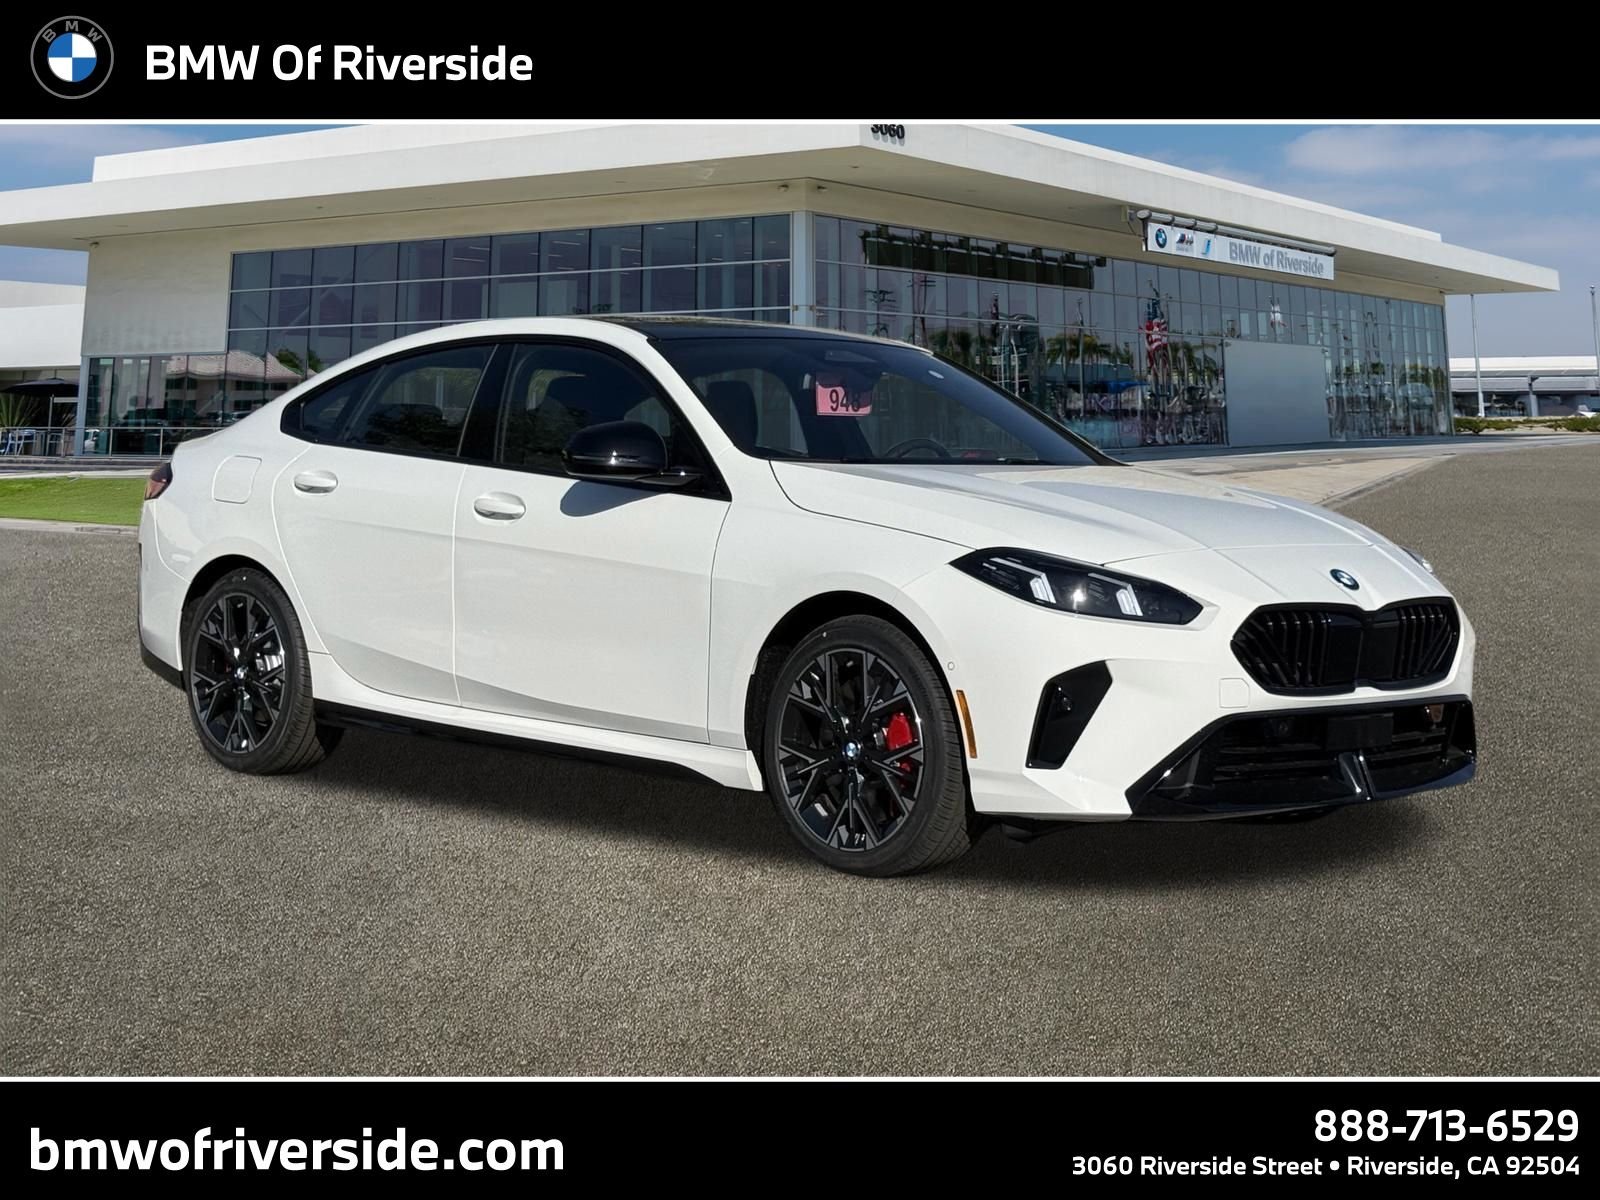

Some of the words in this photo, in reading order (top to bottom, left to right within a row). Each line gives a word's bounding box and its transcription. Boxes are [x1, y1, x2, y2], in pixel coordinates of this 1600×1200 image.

[1229, 241, 1261, 265] BMW
[1263, 249, 1275, 268] of
[1276, 250, 1325, 275] Riverside
